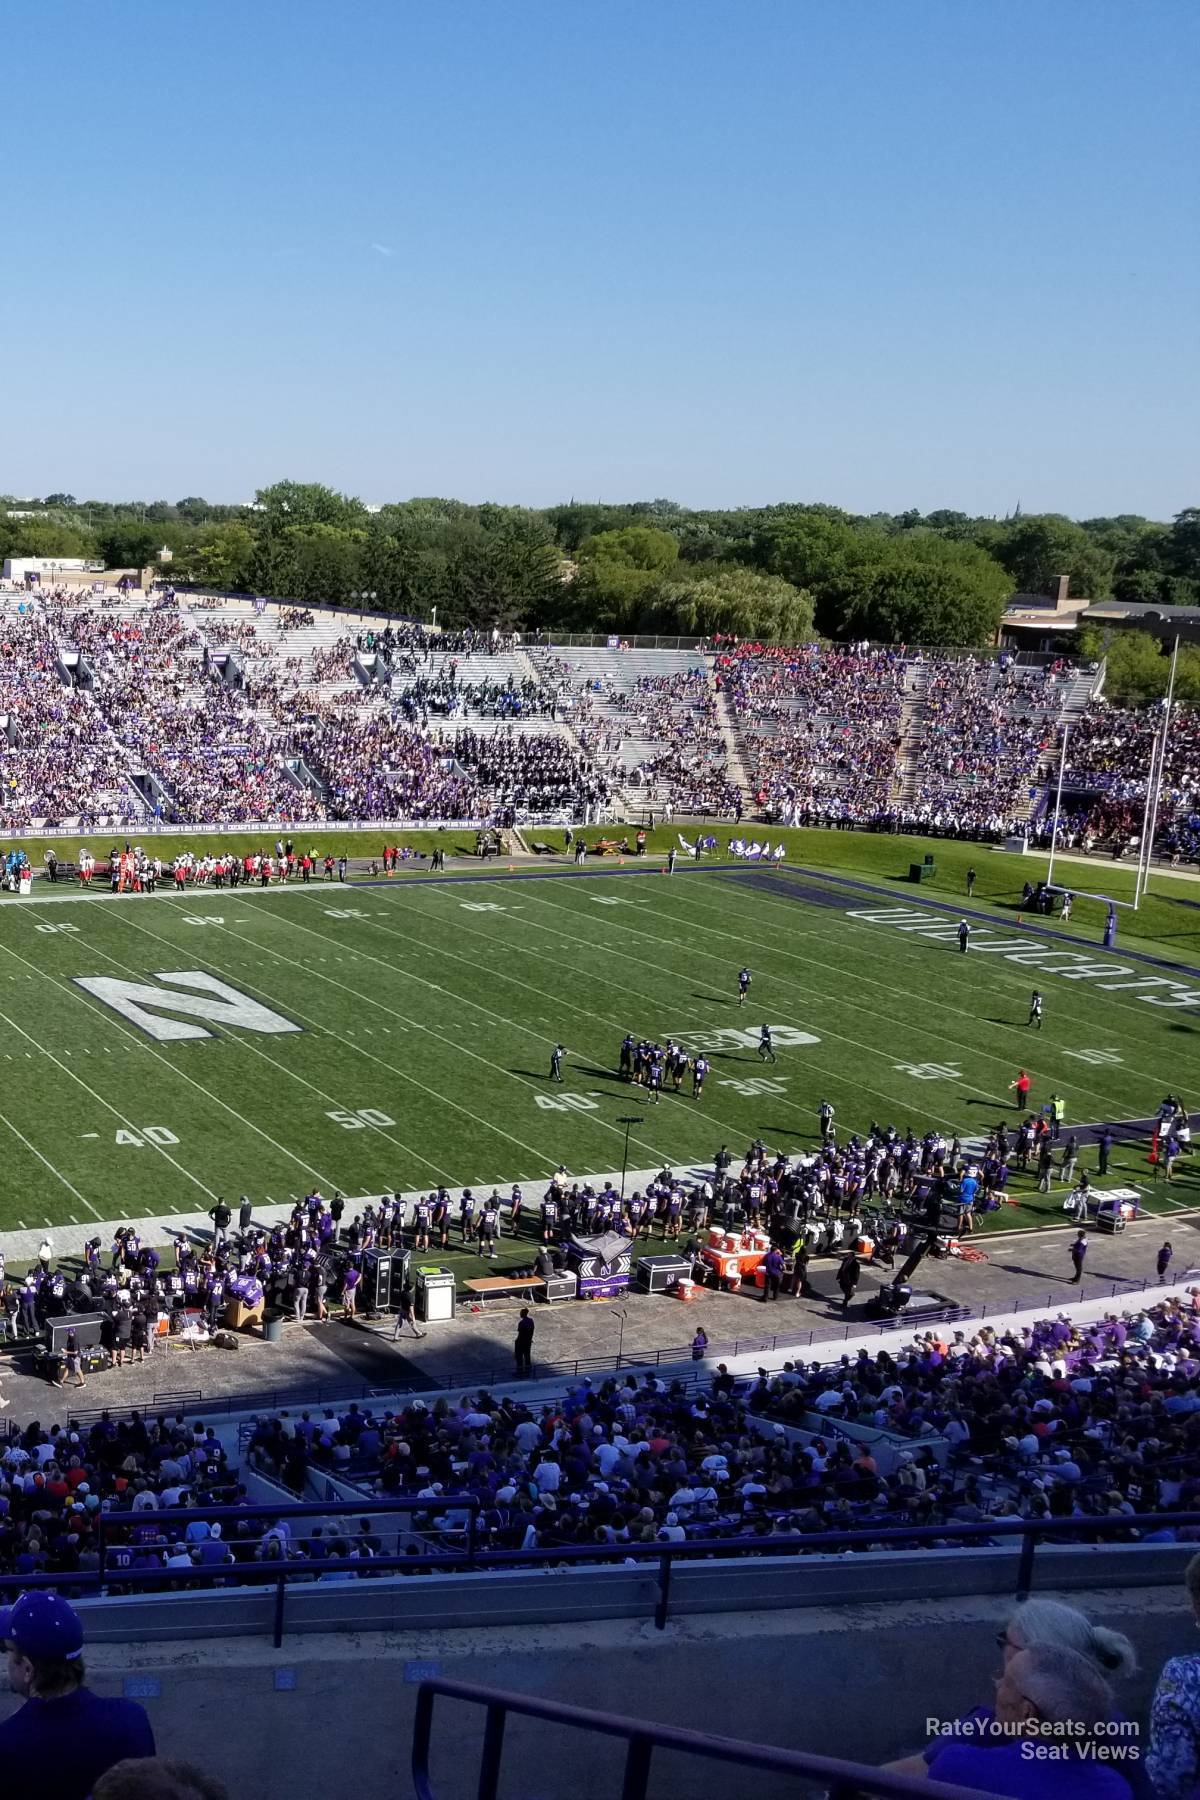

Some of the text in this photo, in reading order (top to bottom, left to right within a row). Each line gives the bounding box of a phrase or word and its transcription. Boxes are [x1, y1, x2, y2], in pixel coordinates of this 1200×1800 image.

[182, 916, 225, 925] 40
[34, 923, 81, 933] 50
[846, 907, 1200, 1008] WILDCATS
[71, 969, 306, 1041] N
[1063, 1049, 1123, 1064] 10
[895, 1063, 959, 1080] 20
[717, 1077, 789, 1096] 30
[533, 1093, 600, 1112] 40
[325, 1108, 397, 1129] 50
[116, 1126, 181, 1147] 40
[419, 1209, 427, 1217] 33
[546, 1207, 554, 1215] 22
[127, 1243, 136, 1251] 50
[726, 1259, 739, 1274] G
[171, 1279, 181, 1289] 99
[185, 1275, 195, 1284] 42
[53, 1285, 64, 1295] 58
[213, 1286, 222, 1296] 44
[116, 1554, 130, 1567] 10
